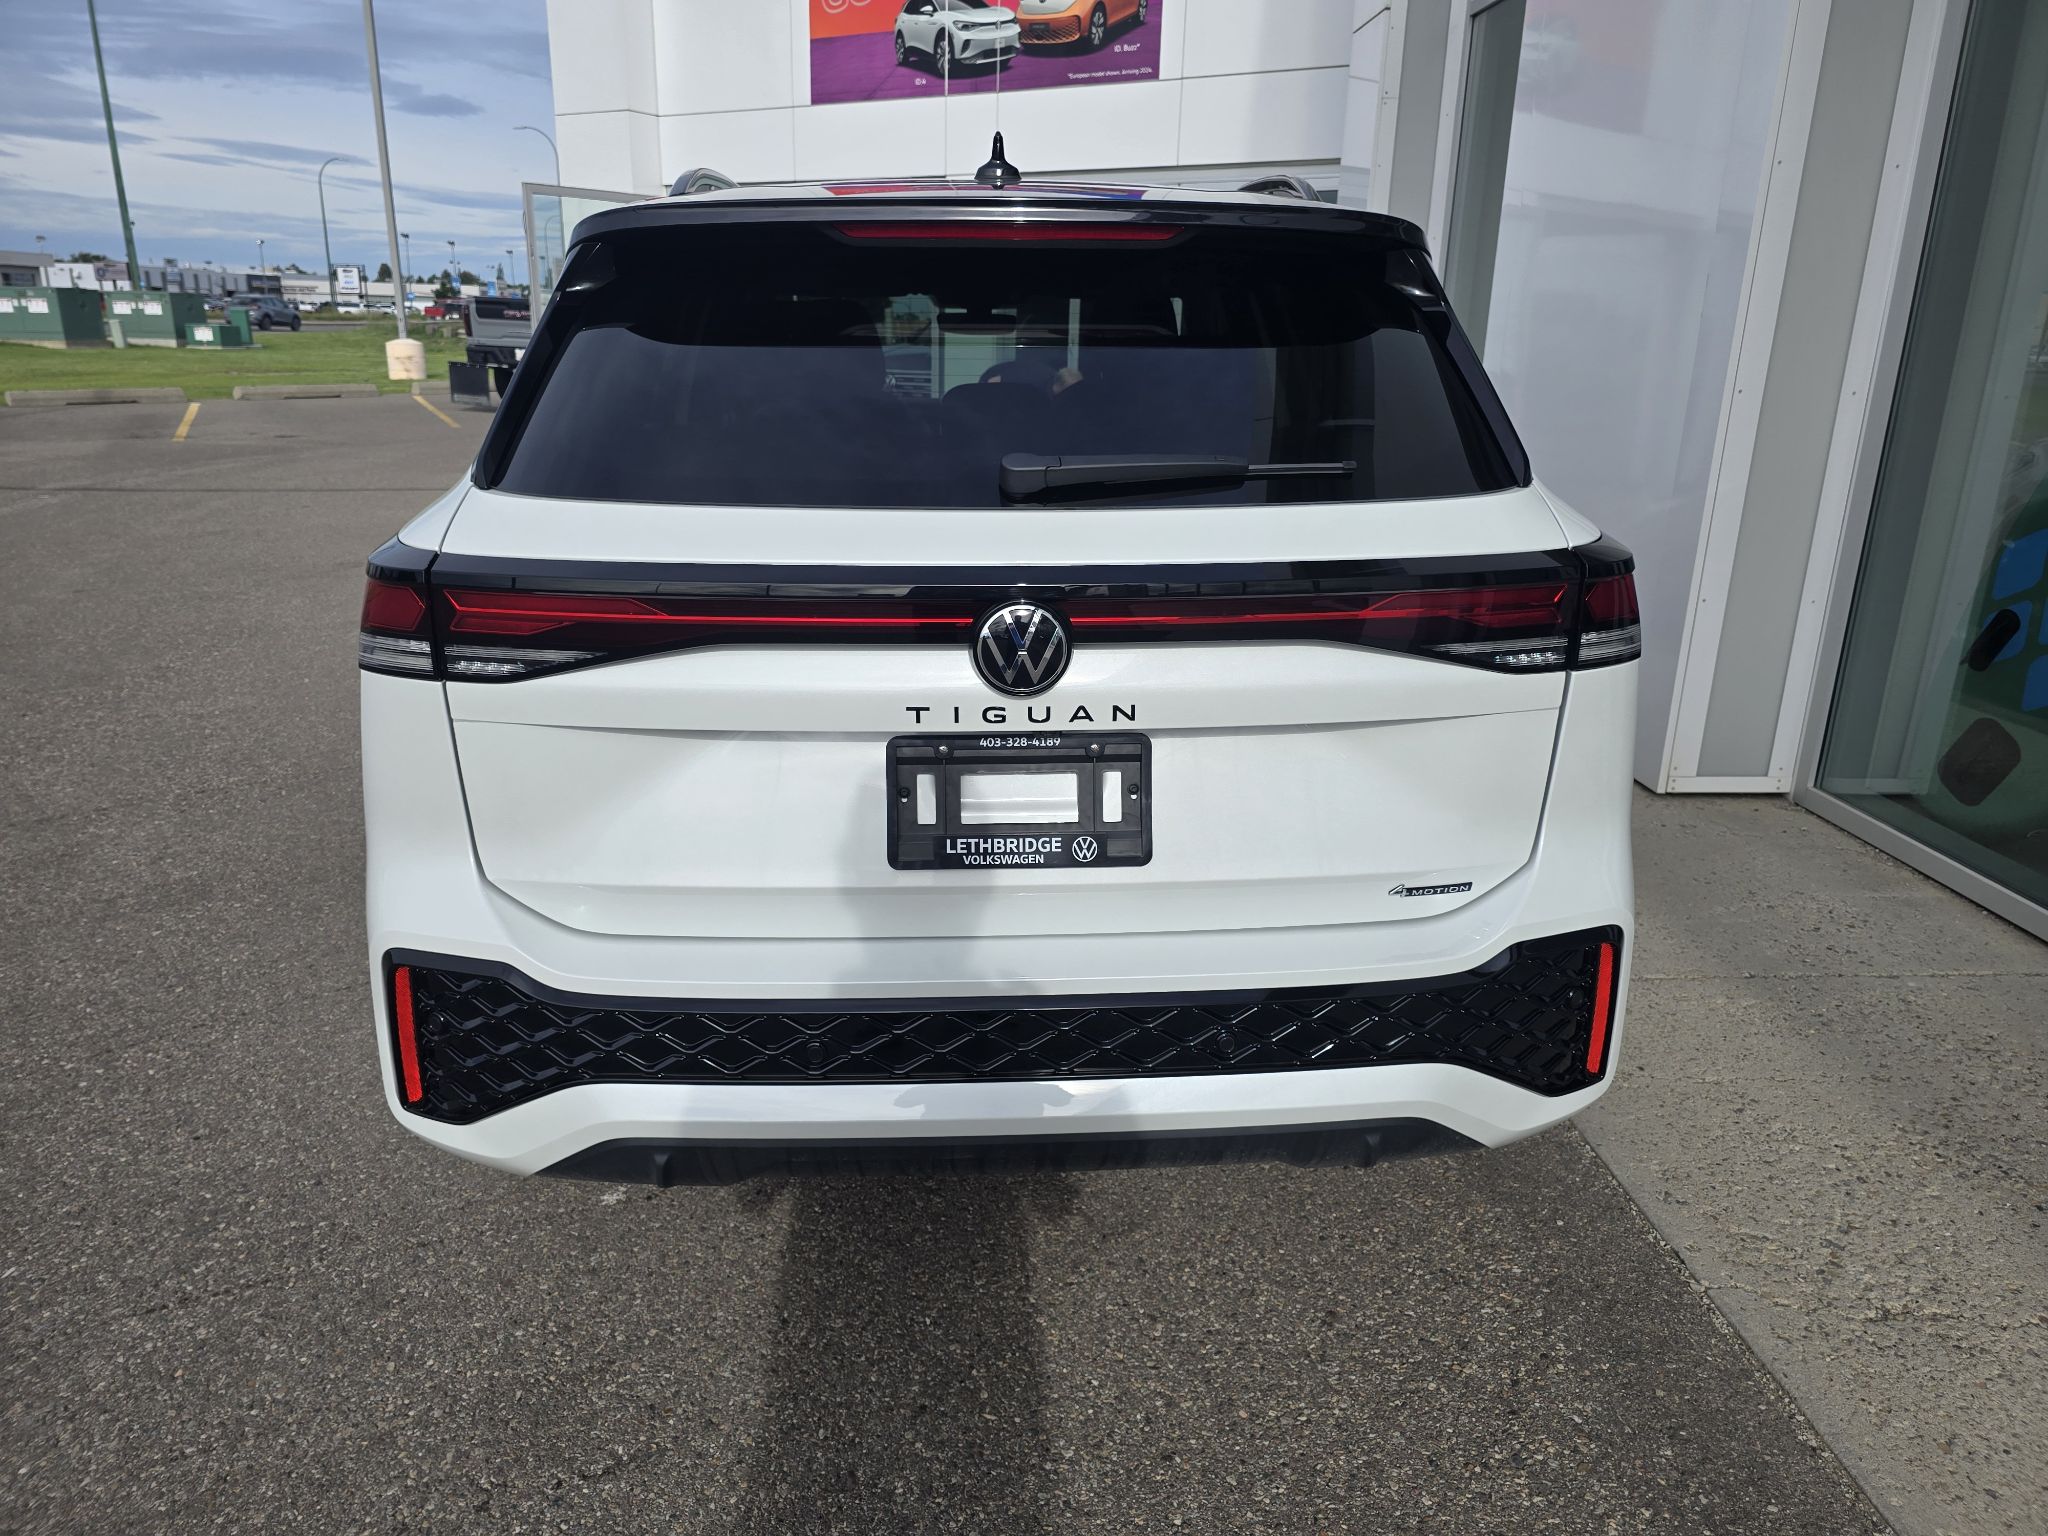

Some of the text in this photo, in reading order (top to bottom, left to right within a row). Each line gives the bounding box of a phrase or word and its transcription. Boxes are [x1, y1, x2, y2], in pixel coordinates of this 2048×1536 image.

[905, 704, 1137, 724] TIGUAN
[946, 837, 1062, 854] LETHBRIDGE
[963, 854, 1044, 865] VOLKSWAGEN
